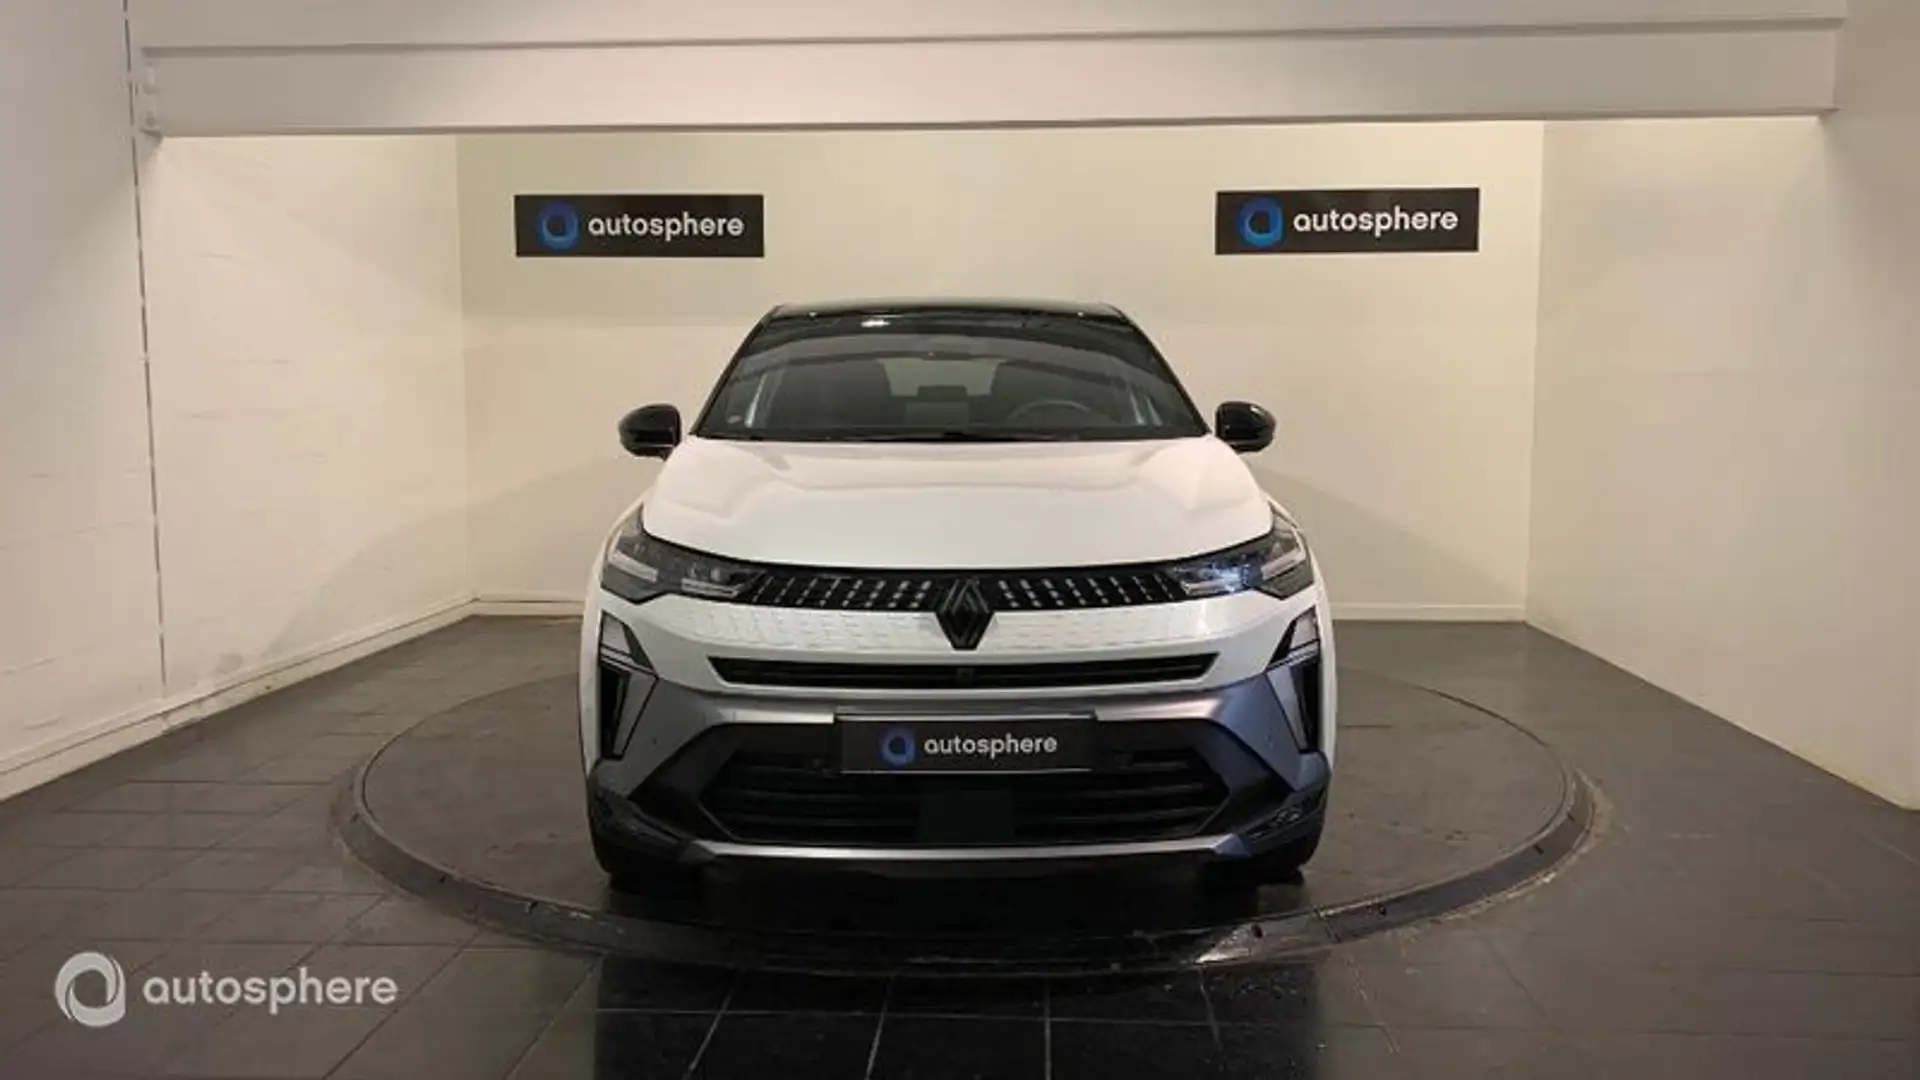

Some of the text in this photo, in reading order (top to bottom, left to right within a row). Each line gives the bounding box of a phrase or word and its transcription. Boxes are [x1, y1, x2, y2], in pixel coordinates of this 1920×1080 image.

[588, 211, 745, 242] autosphere
[1293, 205, 1459, 238] autosphere
[923, 732, 1058, 759] autosphere
